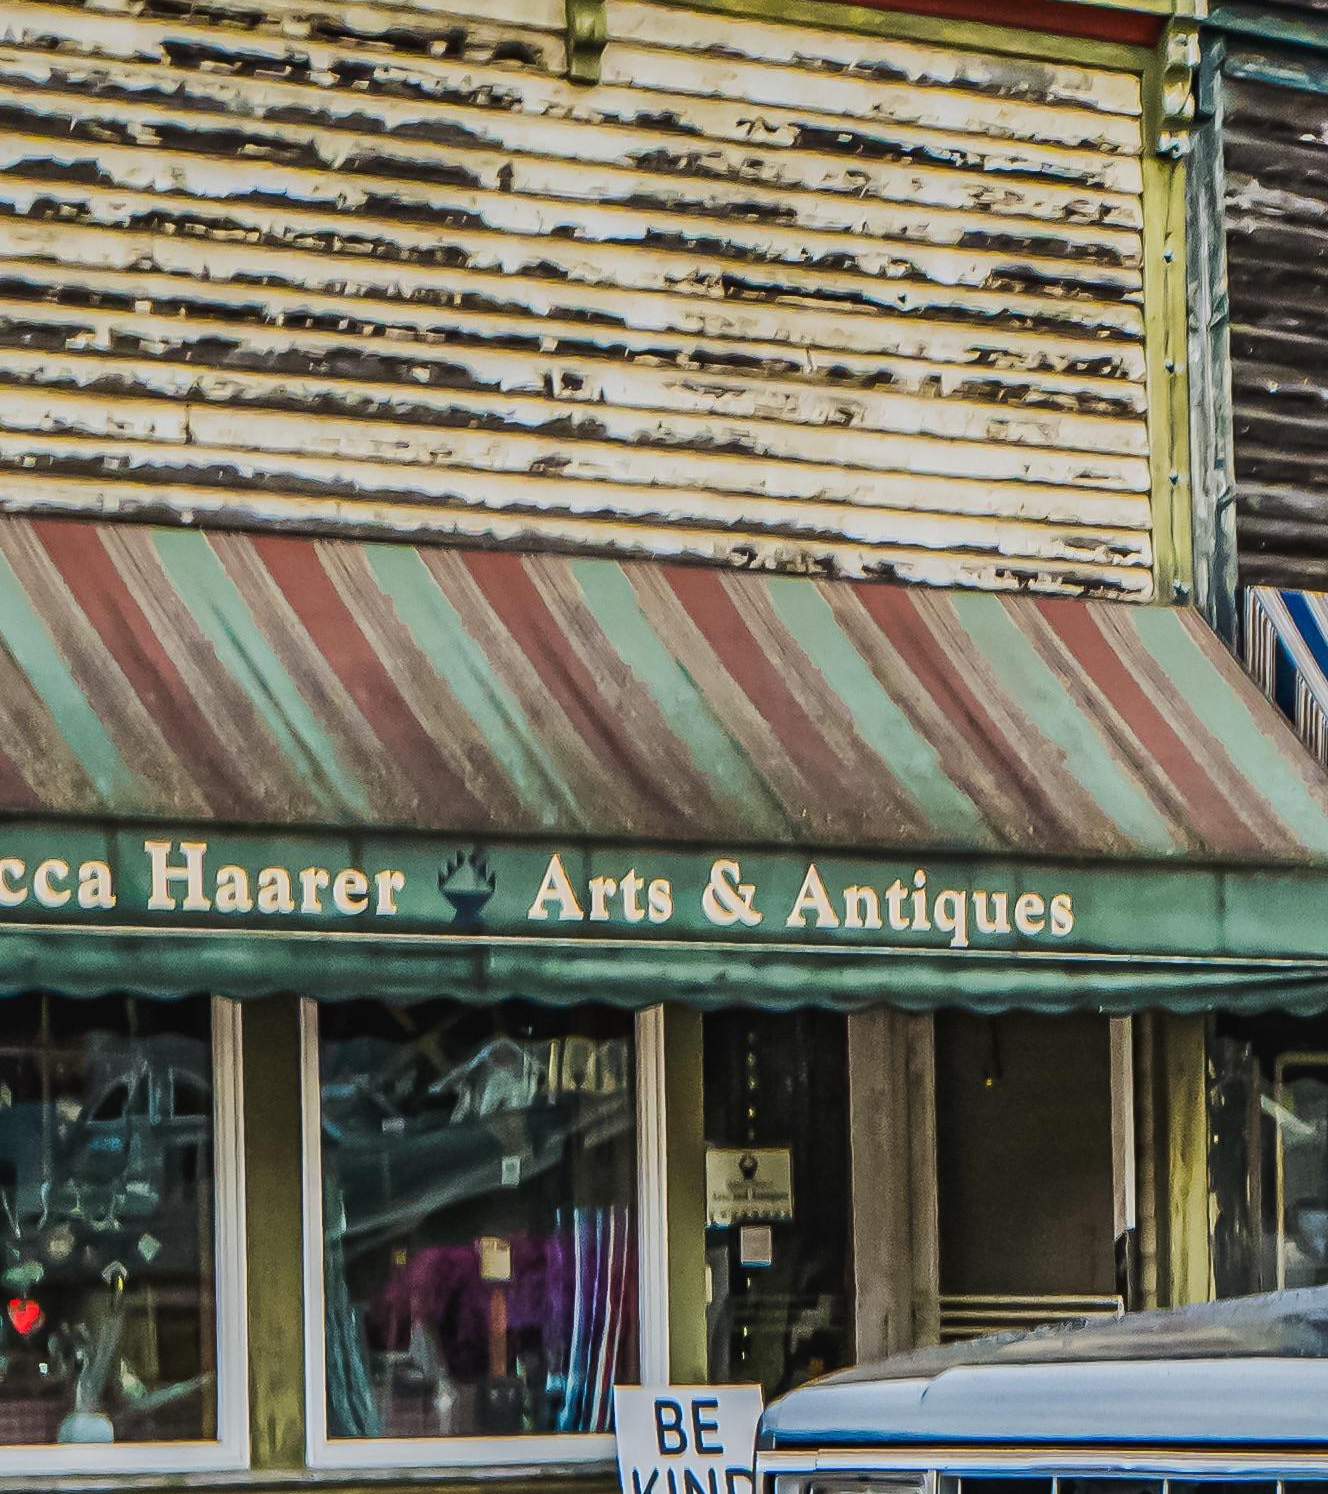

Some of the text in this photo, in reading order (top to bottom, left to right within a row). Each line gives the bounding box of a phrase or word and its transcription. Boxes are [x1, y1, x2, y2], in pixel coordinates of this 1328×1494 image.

[144, 840, 405, 915] Haarer
[528, 853, 672, 923] Arts
[702, 859, 763, 926] &
[785, 864, 1075, 947] Antiques
[654, 1397, 724, 1455] BE
